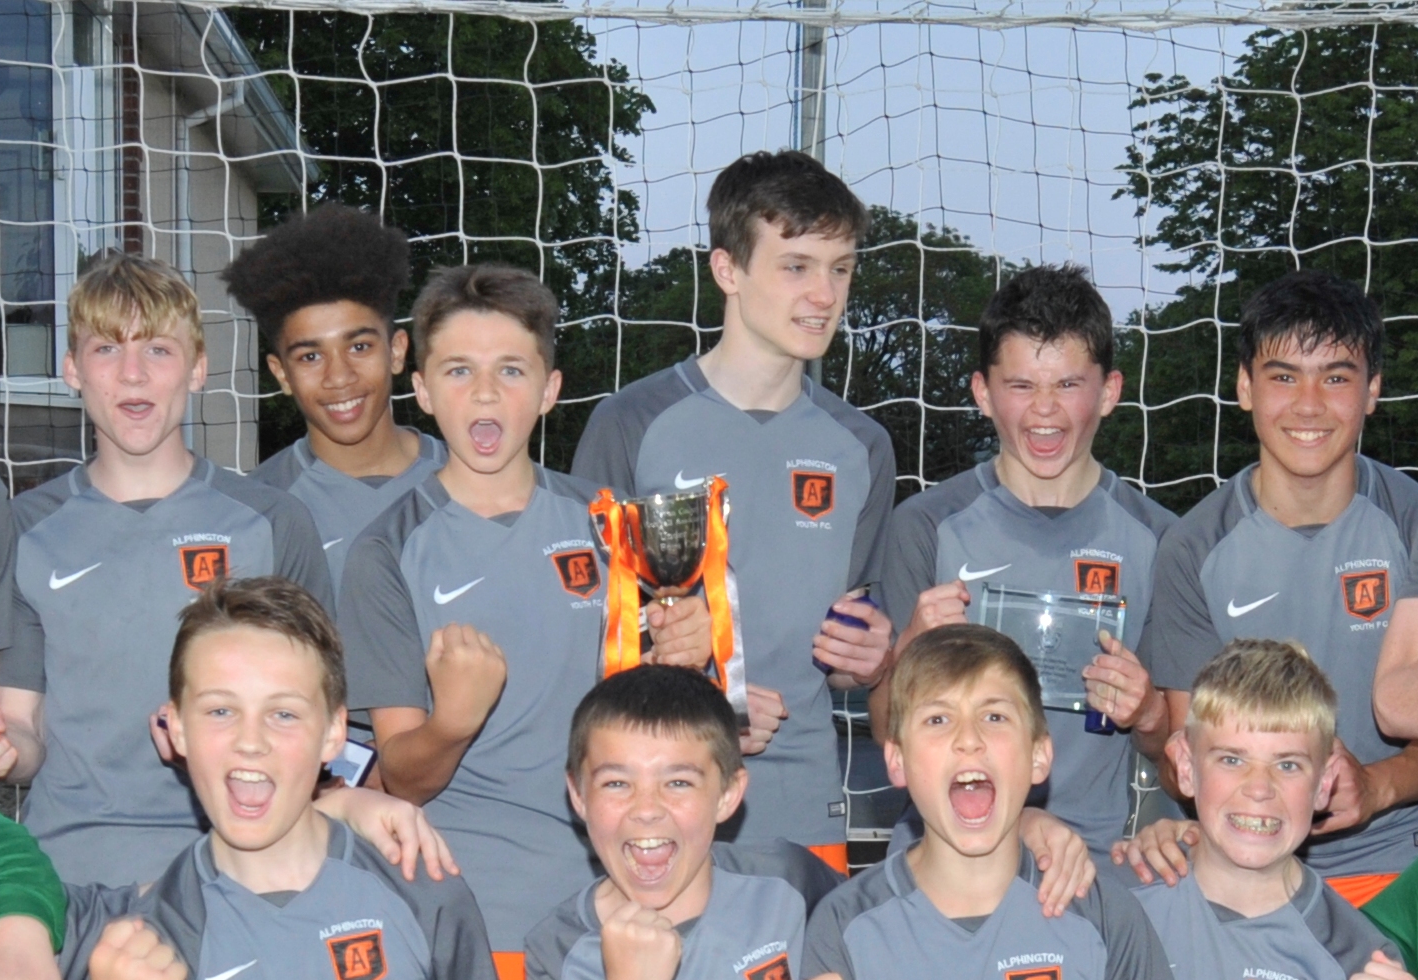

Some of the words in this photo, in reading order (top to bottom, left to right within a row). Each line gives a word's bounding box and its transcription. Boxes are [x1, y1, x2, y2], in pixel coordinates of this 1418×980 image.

[786, 459, 837, 473] ALPHINGTON
[172, 533, 232, 548] ALPHINGTON
[542, 540, 595, 556] ALPHINGTON
[1069, 549, 1123, 563] ALPHINGTON
[1334, 558, 1391, 575] ALPHINGTON
[318, 918, 384, 940] ALPHINGTON
[732, 940, 787, 974] ALPHINGTON
[997, 952, 1064, 972] ALPHINGTON
